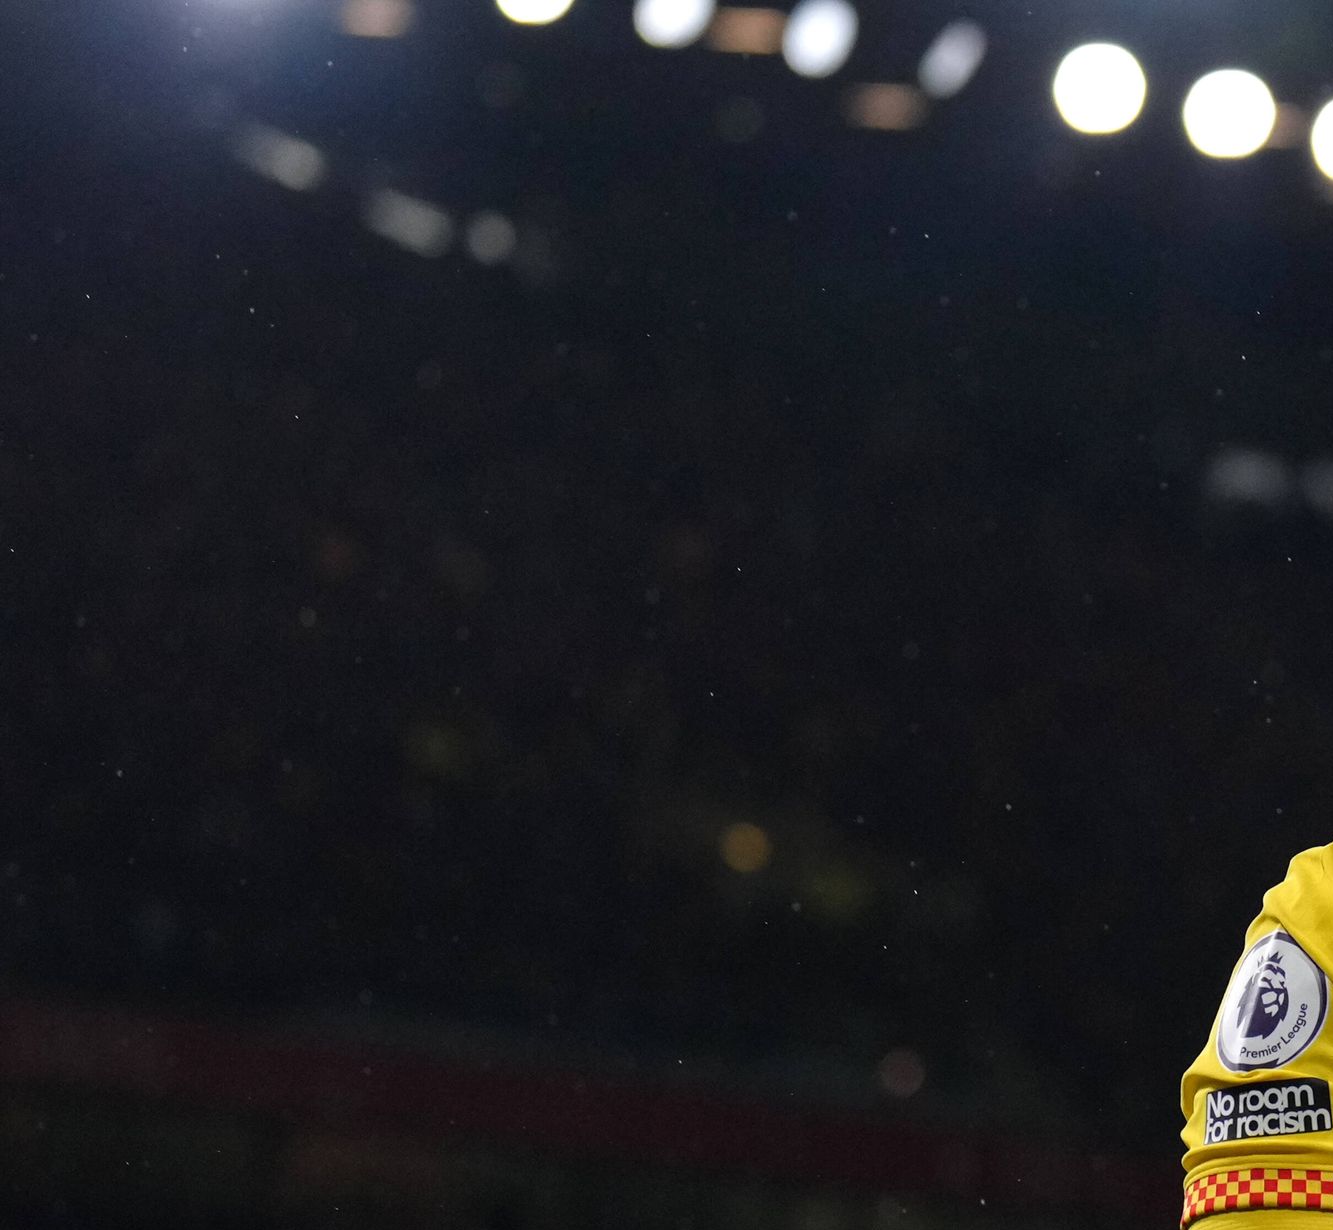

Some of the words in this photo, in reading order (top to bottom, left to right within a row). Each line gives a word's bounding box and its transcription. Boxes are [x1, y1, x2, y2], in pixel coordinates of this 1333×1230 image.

[1240, 1040, 1282, 1059] Premier
[1280, 1003, 1308, 1045] League
[1206, 1091, 1235, 1120] No
[1238, 1084, 1315, 1112] room
[1203, 1117, 1233, 1145] for
[1236, 1107, 1332, 1139] racism
